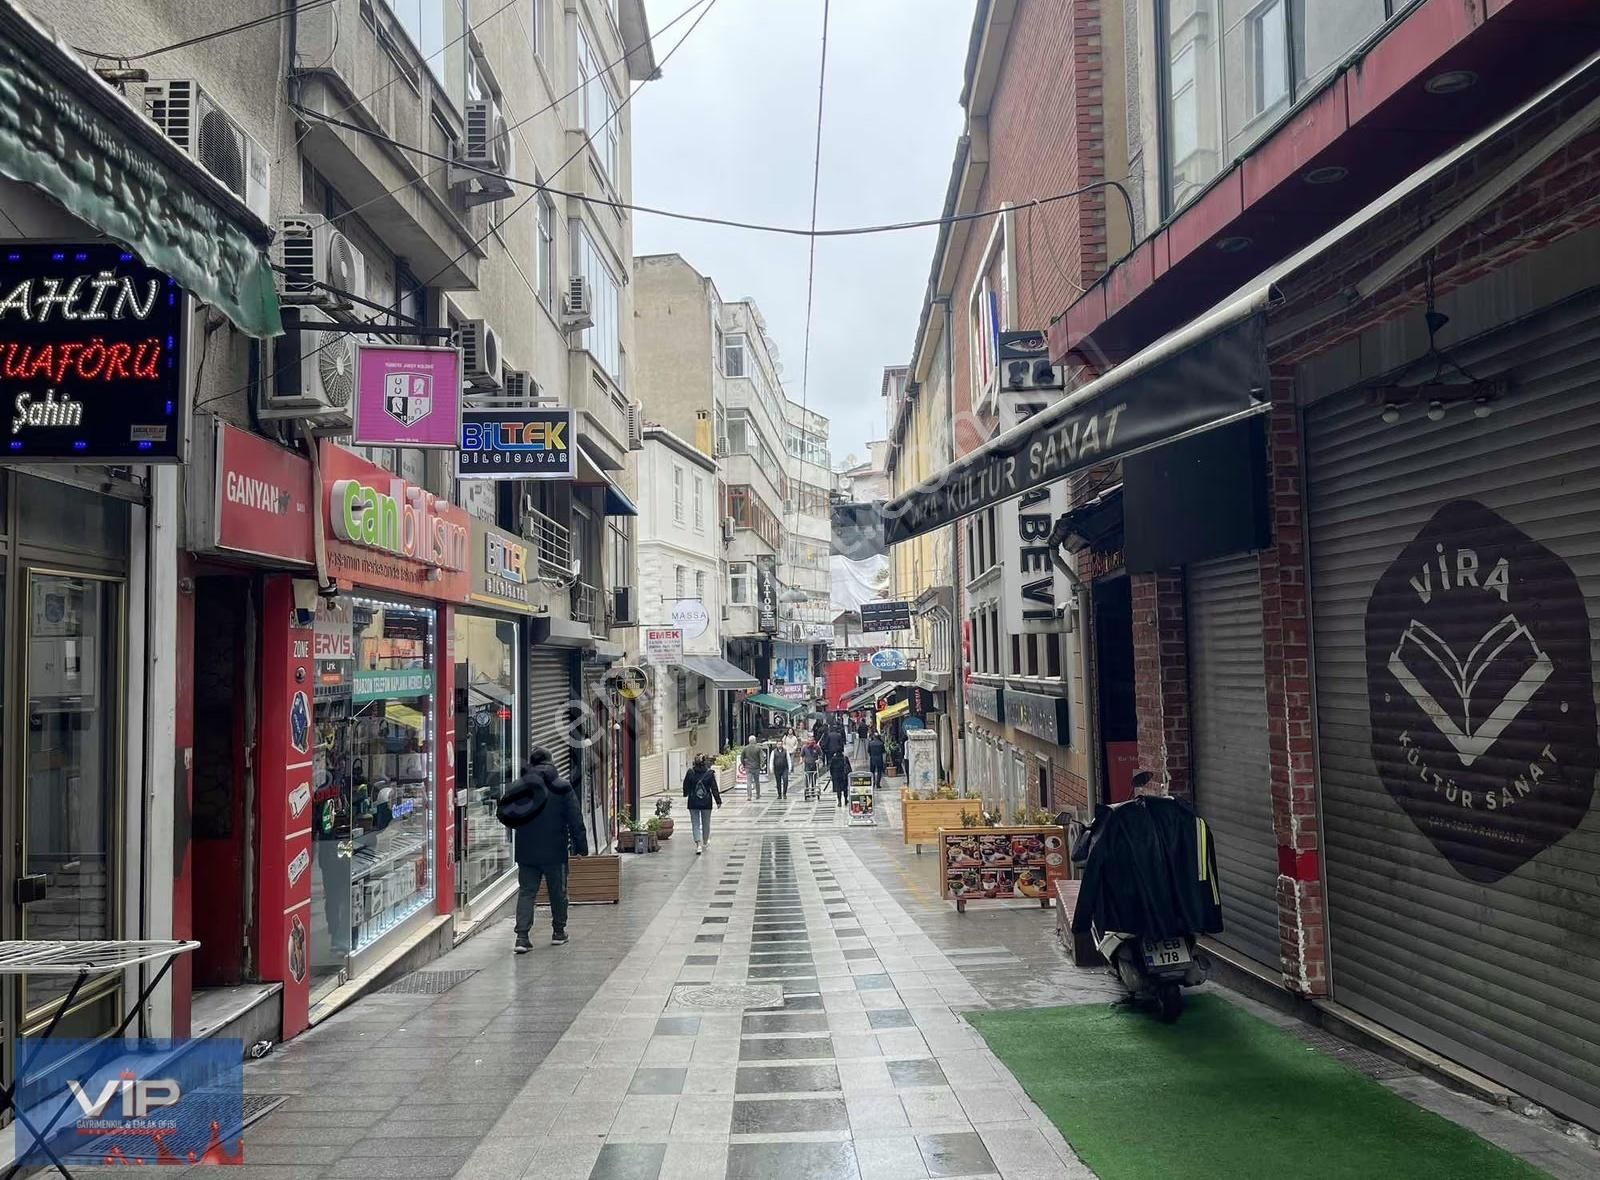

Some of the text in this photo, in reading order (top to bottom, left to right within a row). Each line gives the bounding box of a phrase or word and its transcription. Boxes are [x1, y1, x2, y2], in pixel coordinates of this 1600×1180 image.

[0, 336, 161, 383] UAFÖRÜ
[12, 388, 83, 434] Şahin
[461, 452, 567, 463] BİLGİSAYAR
[1029, 406, 1123, 481] SANAT
[226, 471, 279, 515] GANYAN
[763, 570, 772, 611] TATTOO
[1409, 543, 1510, 603] VİRA
[649, 631, 680, 640] EMEK
[671, 611, 707, 620] MASSA
[1399, 729, 1558, 810] KÜLTÜR SANAT
[1160, 951, 1179, 963] 178
